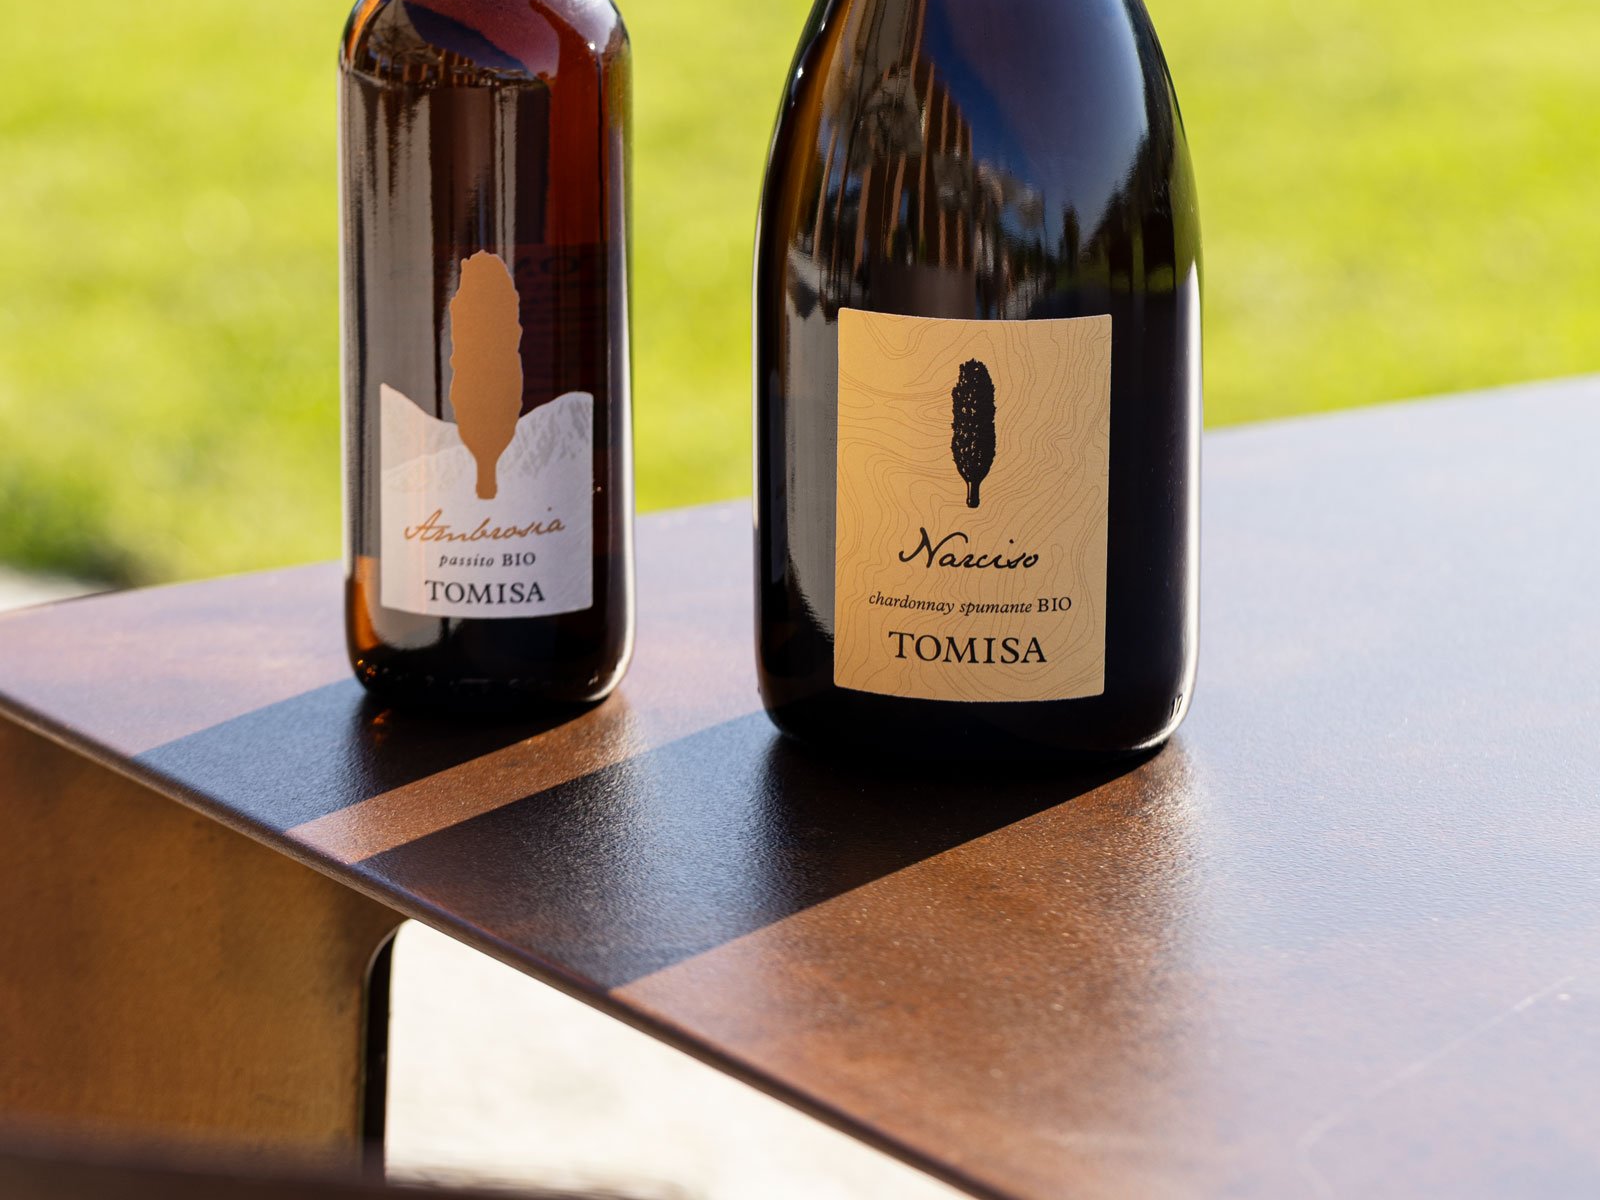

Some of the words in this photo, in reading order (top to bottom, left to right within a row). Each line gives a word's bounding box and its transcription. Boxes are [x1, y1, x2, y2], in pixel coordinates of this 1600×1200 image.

[404, 507, 567, 543] Ambrosia
[438, 552, 495, 568] passito
[502, 552, 536, 567] BIO
[898, 527, 1039, 569] Narciso
[425, 579, 546, 604] TOMISA
[868, 591, 955, 615] chardonnay
[959, 598, 1033, 615] spumante
[1037, 597, 1072, 613] BIO
[888, 631, 1048, 665] TOMISA
